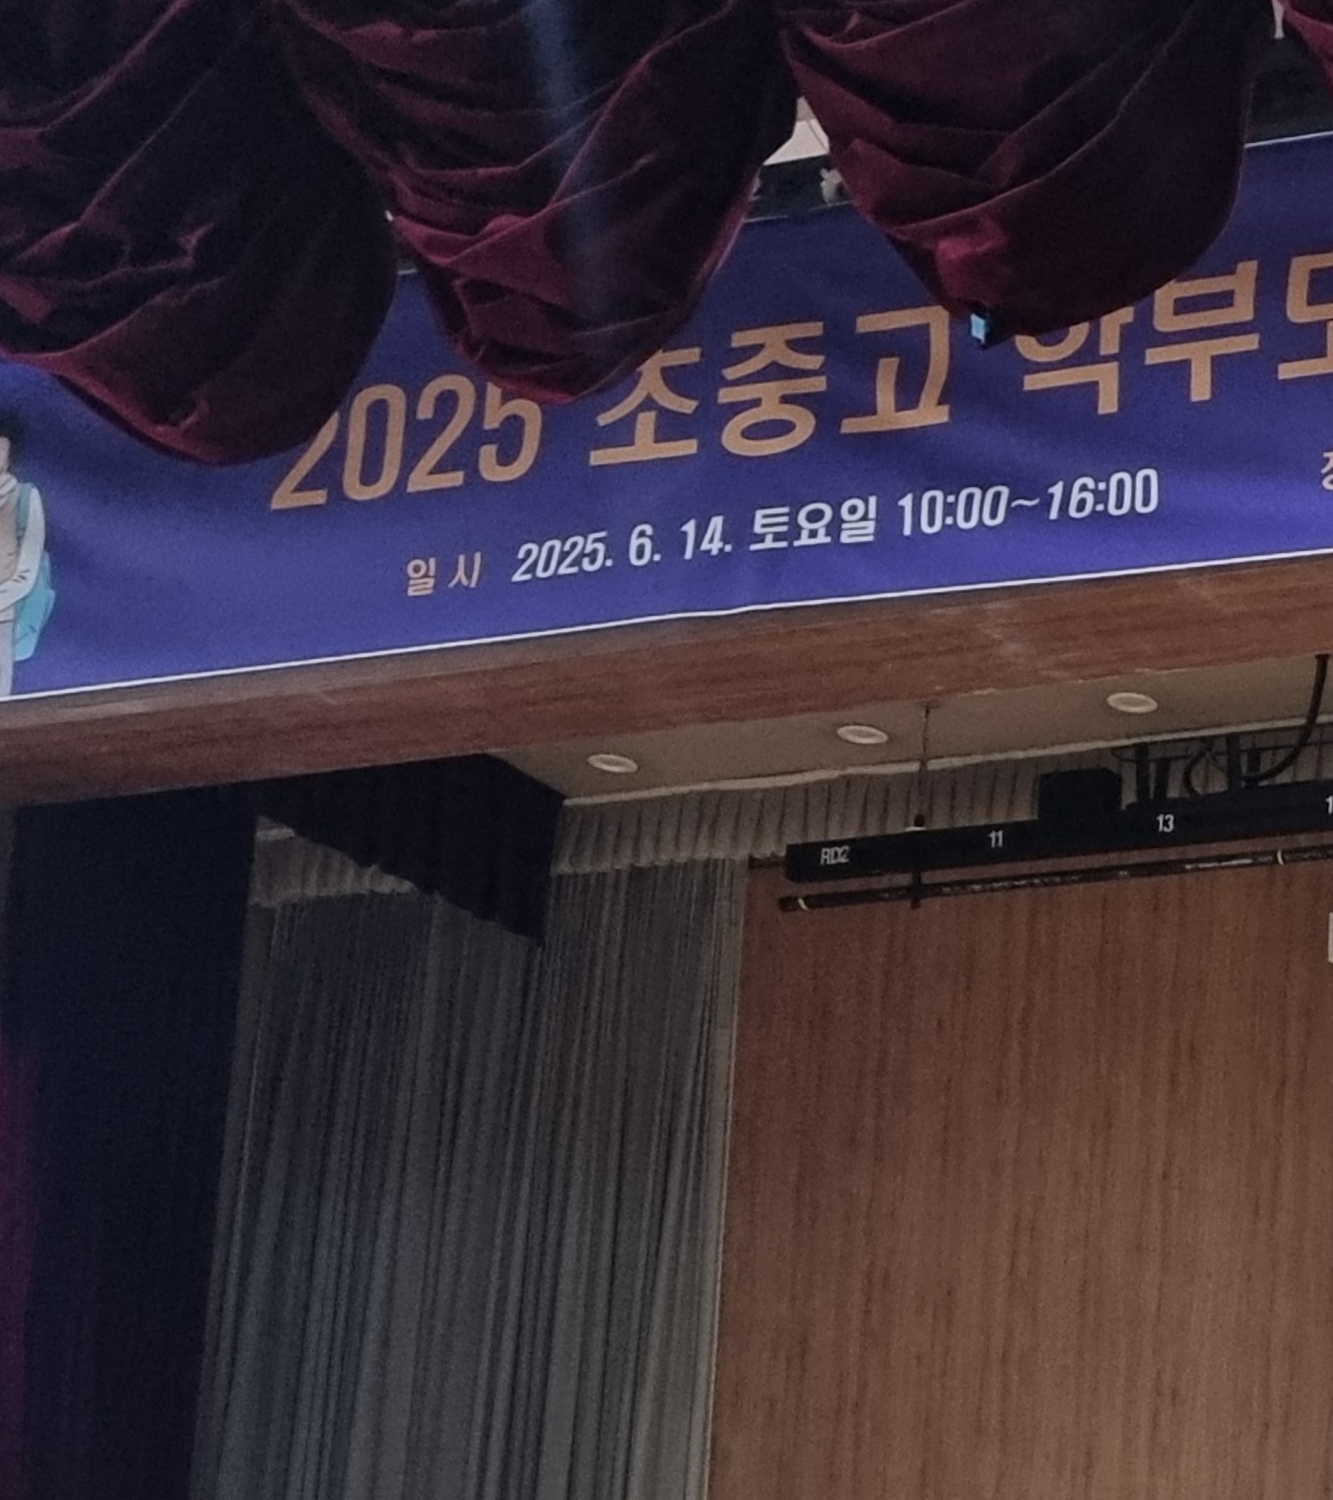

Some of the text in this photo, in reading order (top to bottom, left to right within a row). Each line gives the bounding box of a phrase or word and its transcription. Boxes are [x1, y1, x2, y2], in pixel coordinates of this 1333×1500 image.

[270, 374, 543, 510] 2025
[511, 531, 613, 582] 2025.
[628, 523, 661, 567] 6.
[680, 515, 733, 560] 14.
[748, 495, 877, 551] 토요일
[897, 468, 1159, 537] 10:00~16:00
[1156, 813, 1175, 833] 13
[988, 830, 1004, 848] 11
[820, 845, 850, 865] RD2
